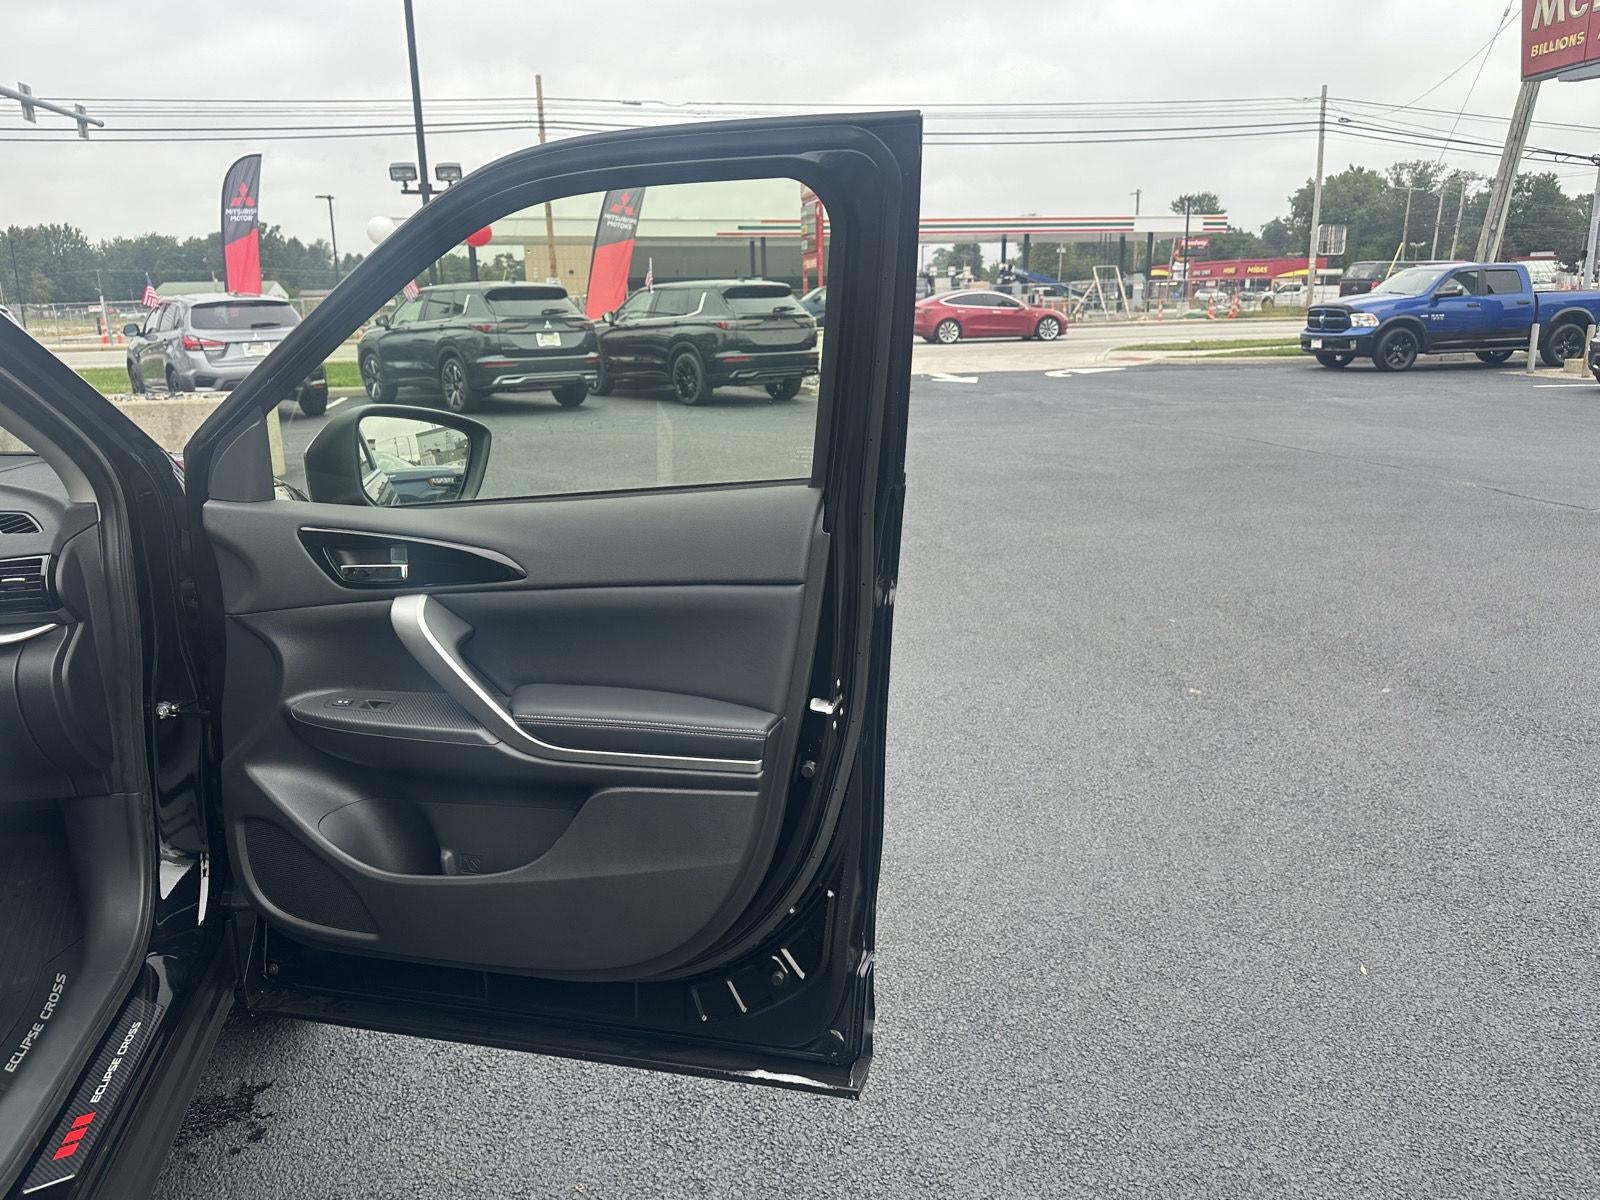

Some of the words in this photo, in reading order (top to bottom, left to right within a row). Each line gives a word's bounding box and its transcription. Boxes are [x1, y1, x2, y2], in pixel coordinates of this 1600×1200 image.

[1530, 31, 1585, 57] BILLIONS
[4, 1022, 44, 1073] ECLIPSE
[40, 972, 67, 1020] CROSS
[90, 1057, 122, 1103] ECLIPSE
[117, 1021, 142, 1055] CROSS
